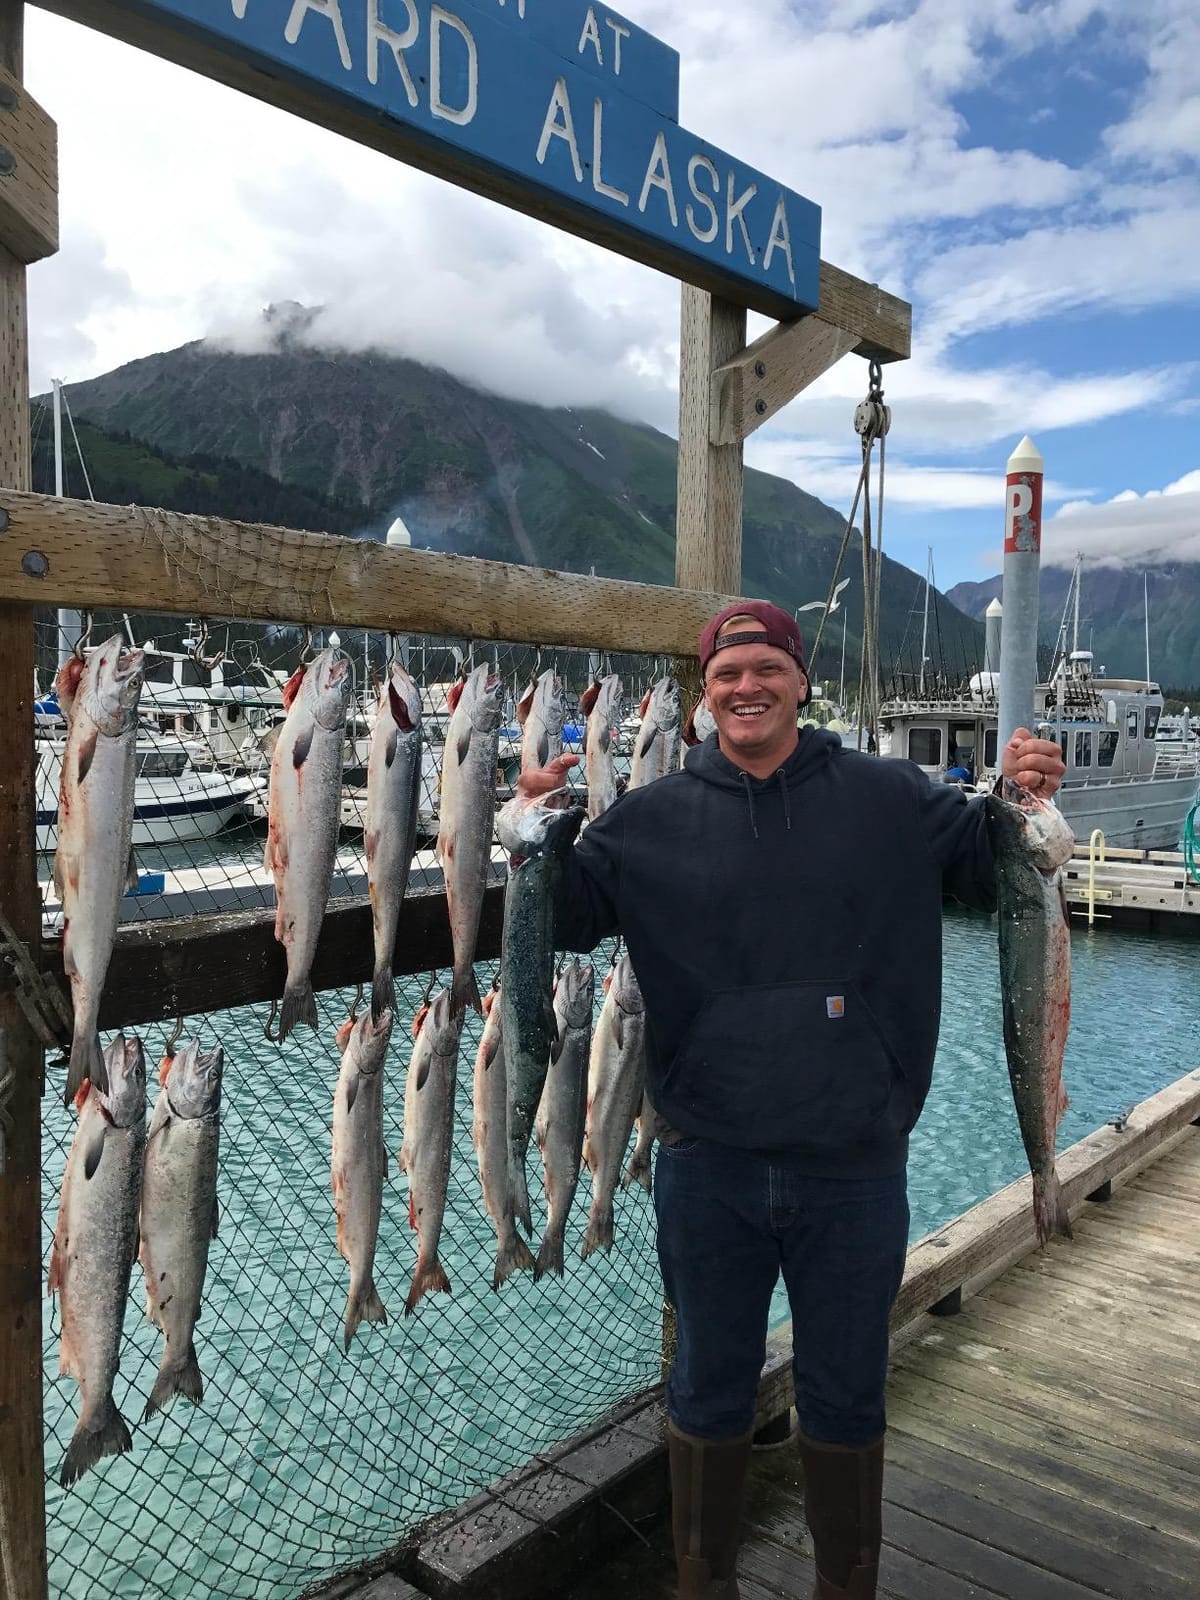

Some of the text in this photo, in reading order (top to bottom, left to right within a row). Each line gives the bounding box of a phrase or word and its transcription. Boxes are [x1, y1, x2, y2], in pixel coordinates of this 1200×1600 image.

[577, 7, 630, 76] AT
[231, 0, 796, 284] ARD ALASKA
